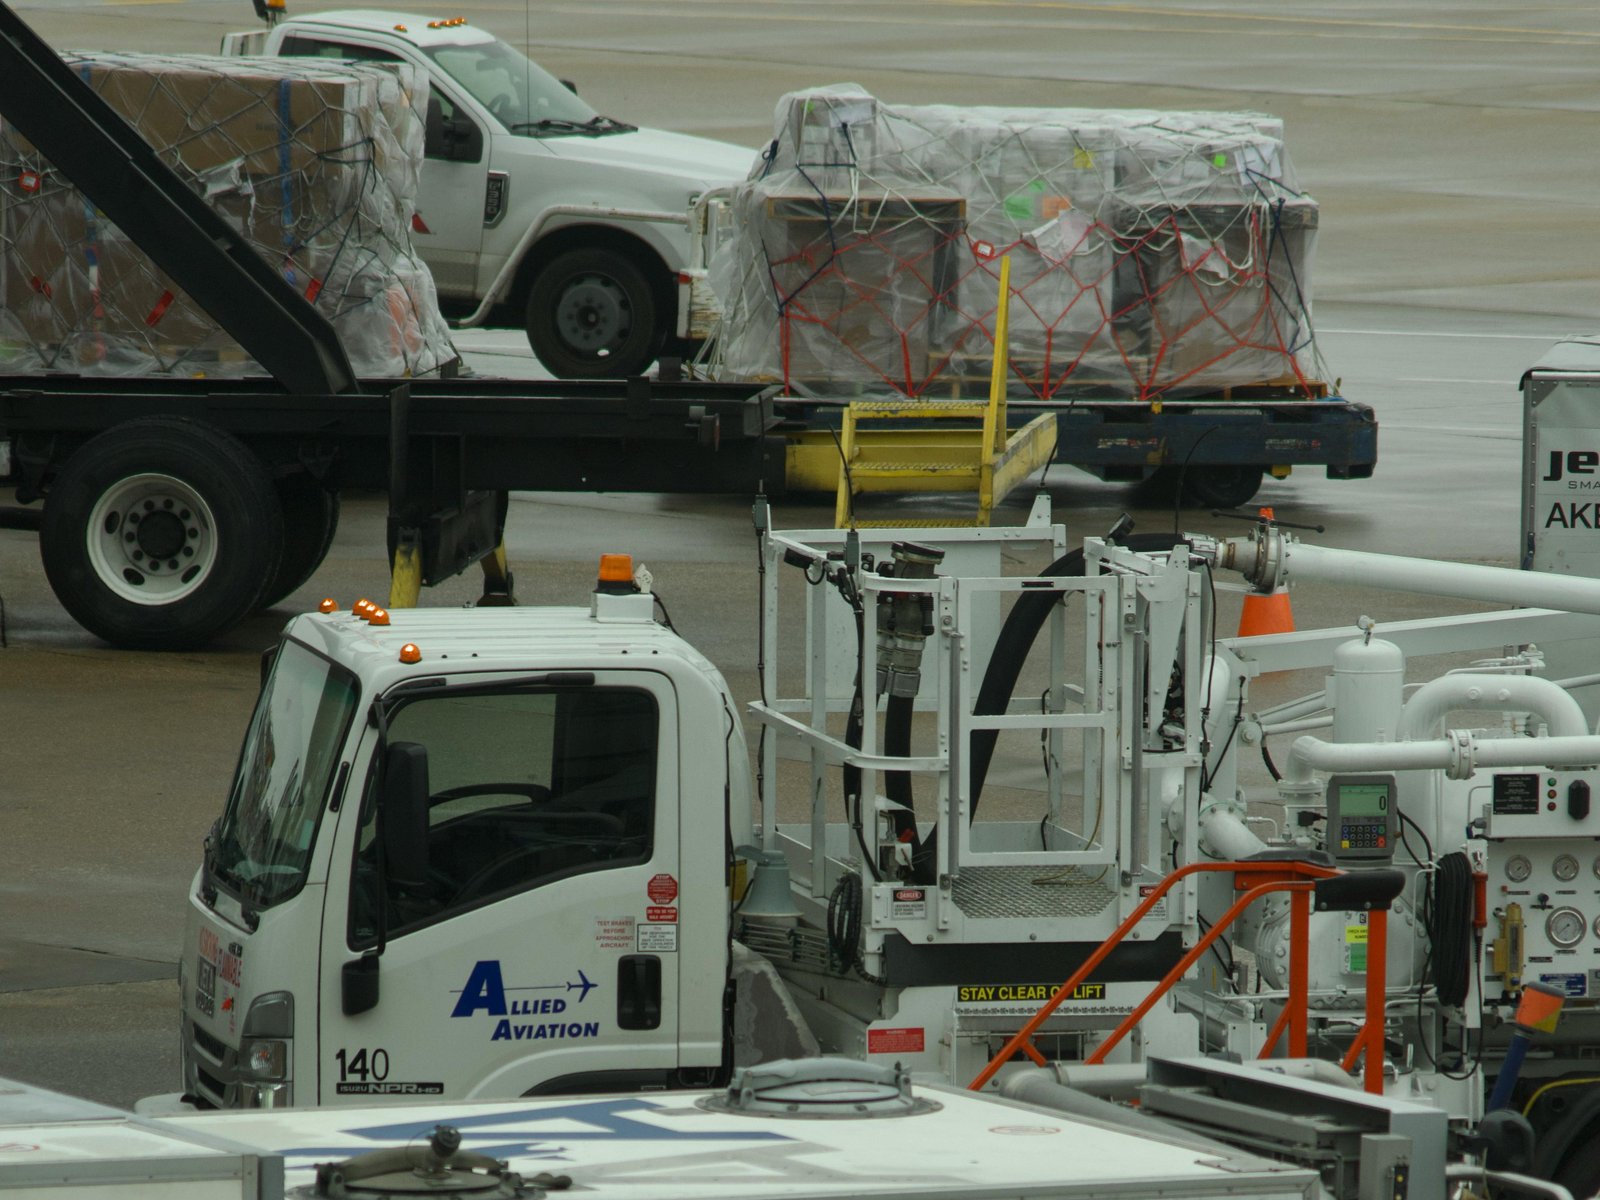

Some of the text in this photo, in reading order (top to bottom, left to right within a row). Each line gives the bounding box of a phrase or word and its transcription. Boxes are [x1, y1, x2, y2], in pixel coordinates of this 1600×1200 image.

[1379, 795, 1387, 811] 0
[451, 960, 566, 1018] ALLIED
[960, 987, 995, 1000] STAY
[999, 986, 1046, 1000] CLEAR
[1074, 985, 1103, 999] LIFT
[491, 1019, 600, 1041] AVIATION
[335, 1048, 389, 1082] 140
